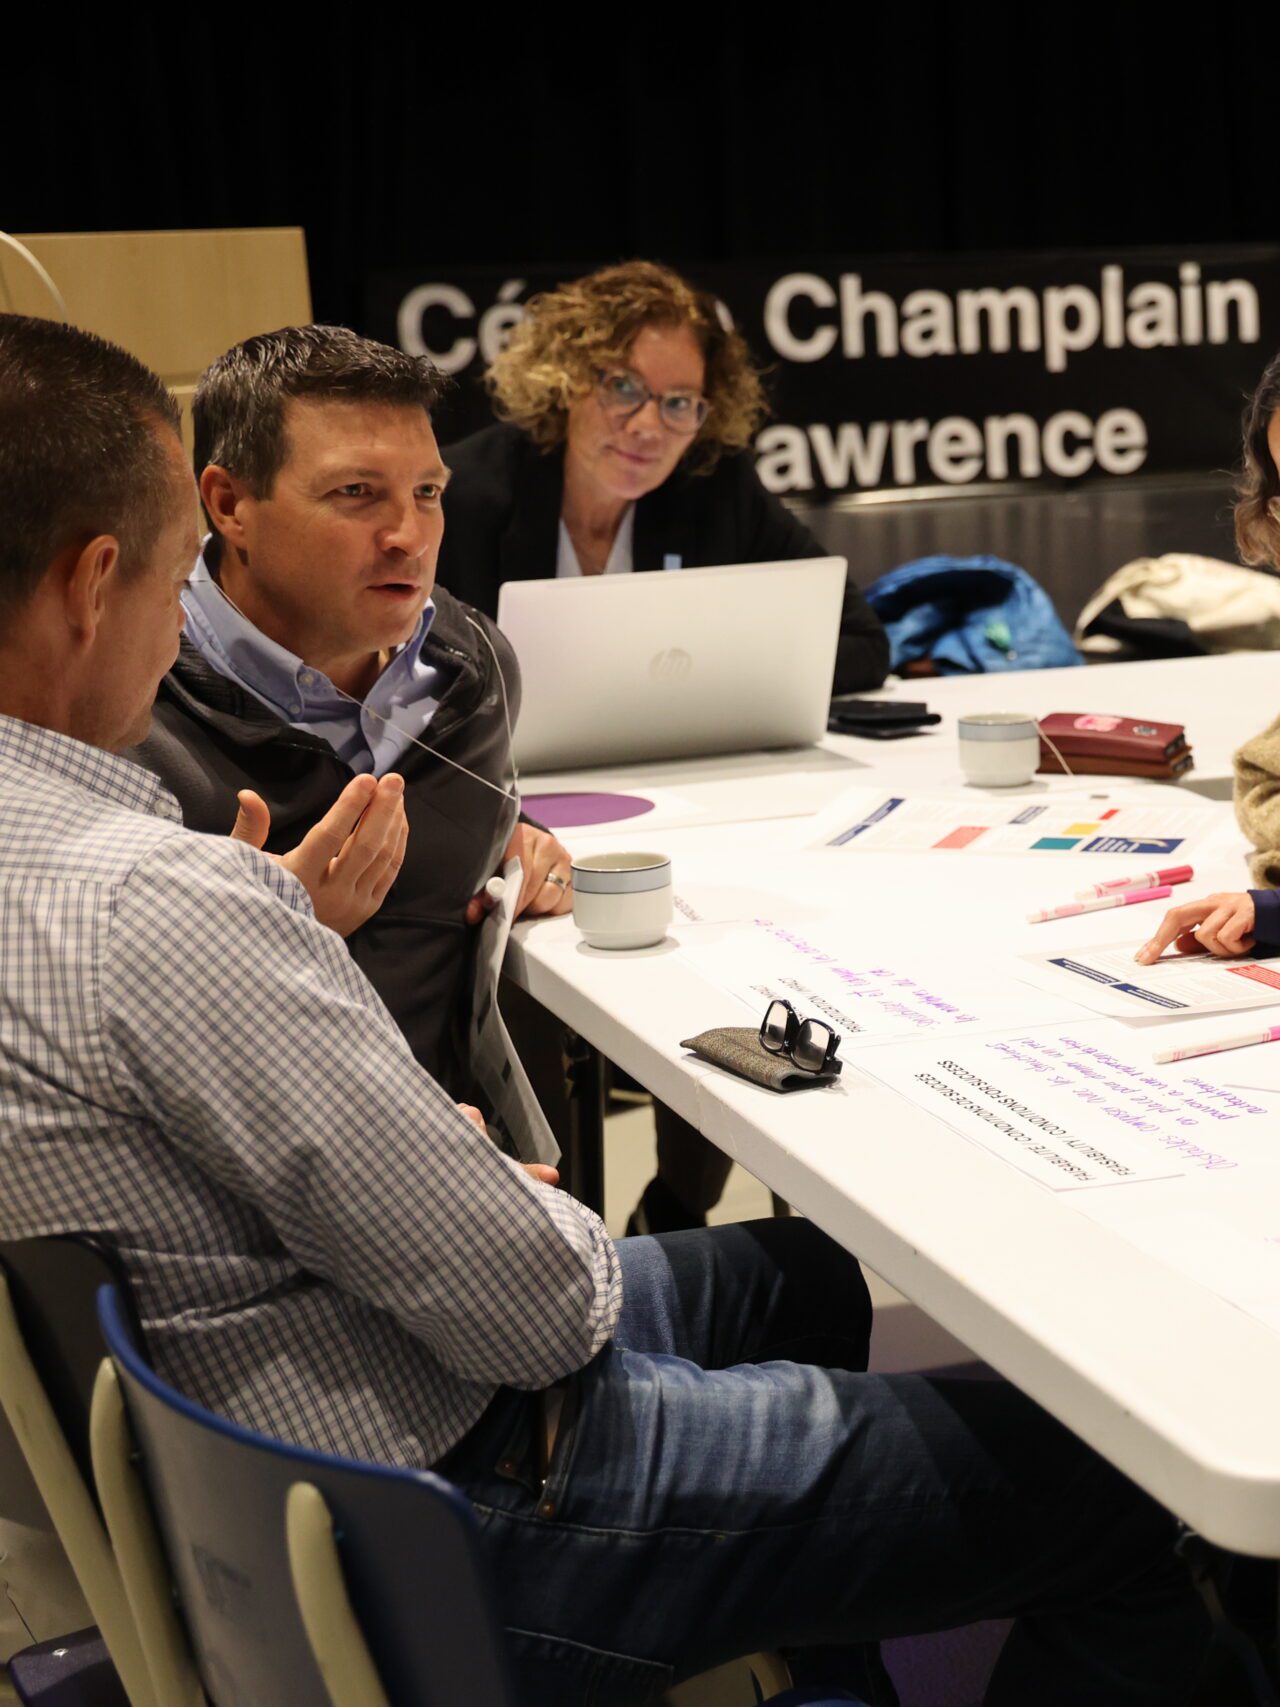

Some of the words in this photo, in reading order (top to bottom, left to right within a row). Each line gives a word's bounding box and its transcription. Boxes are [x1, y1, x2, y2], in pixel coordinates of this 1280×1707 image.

[763, 261, 1260, 373] Champlain
[755, 407, 1148, 493] awrence
[937, 1060, 988, 1086] SUCCESS
[949, 1096, 974, 1105] DE
[978, 1085, 1008, 1099] FOR
[963, 1105, 1032, 1142] CONDITIONS
[997, 1098, 1067, 1135] CONDITIONS
[1061, 1140, 1136, 1176] FEASABILITY
